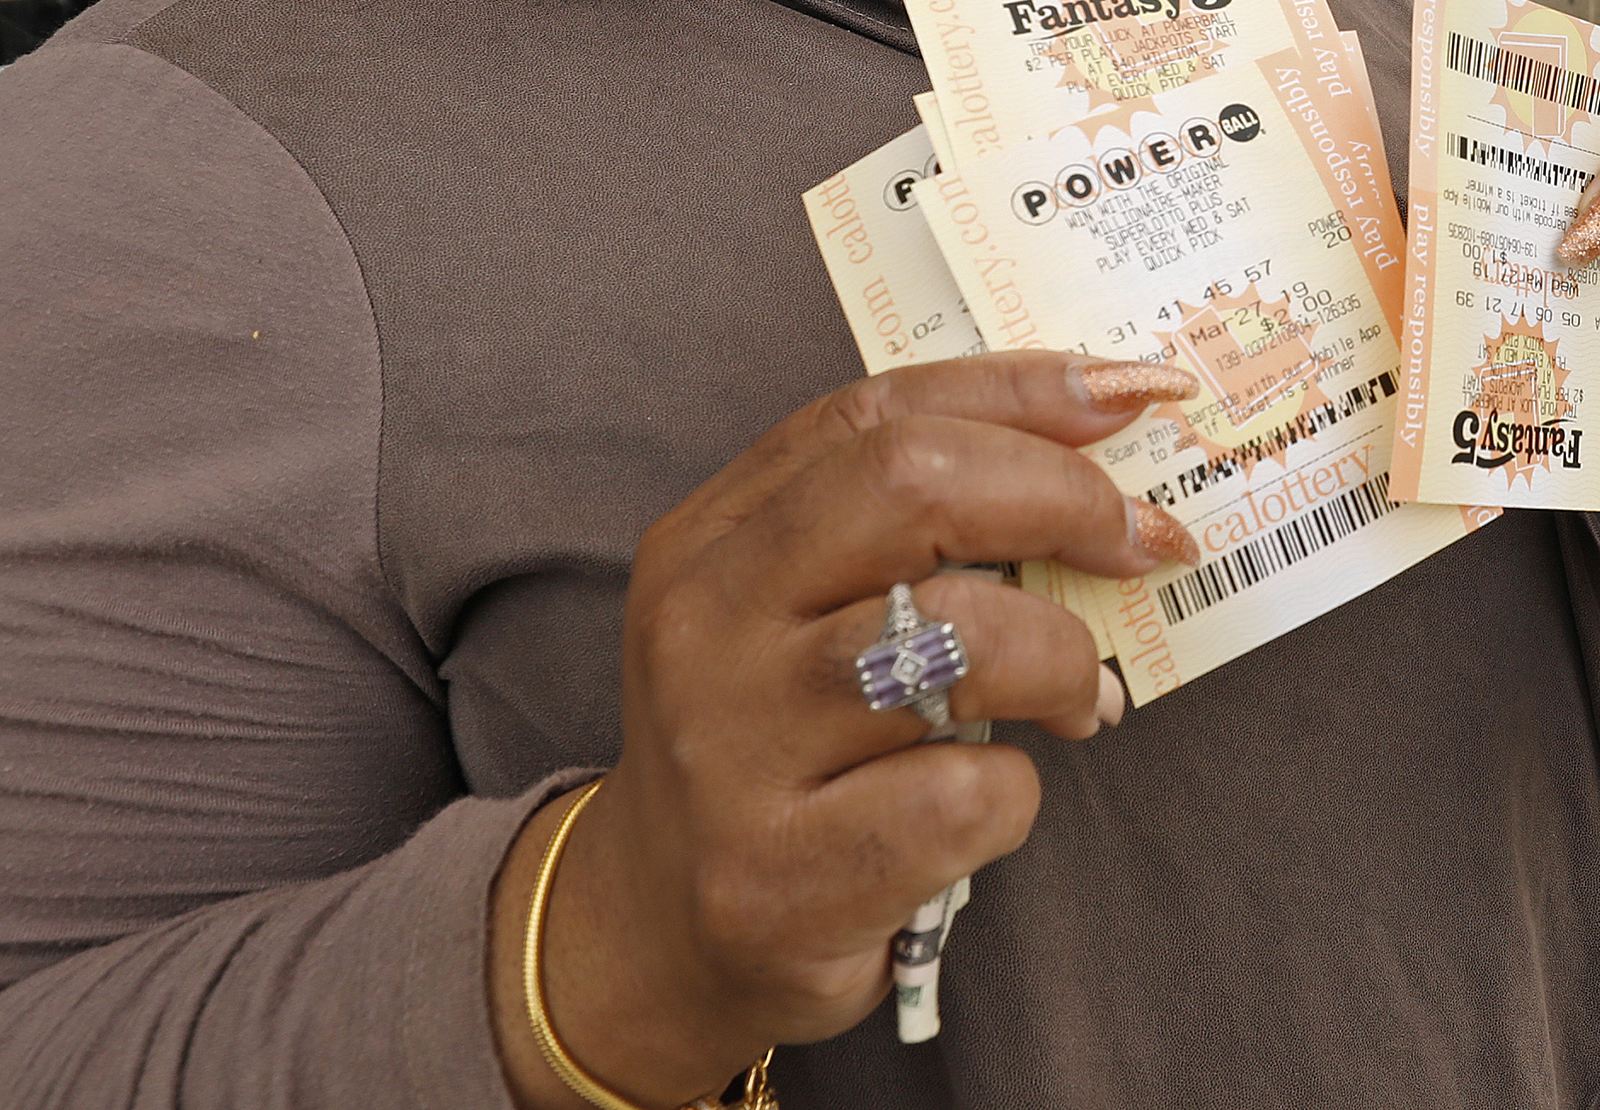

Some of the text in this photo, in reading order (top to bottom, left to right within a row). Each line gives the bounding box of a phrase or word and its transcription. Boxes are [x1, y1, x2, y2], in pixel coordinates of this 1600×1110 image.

[1062, 35, 1094, 50] YOUR
[1141, 24, 1156, 37] AT
[1164, 12, 1235, 33] POWERBALL
[1131, 32, 1195, 53] JACKPOTS
[1200, 24, 1238, 41] START
[1066, 78, 1101, 94] PLAY
[1108, 70, 1149, 88] EVERY
[1157, 63, 1182, 78] WED
[1201, 54, 1227, 69] SAT
[1111, 76, 1191, 101] QUICK PICK
[1065, 211, 1094, 230] WIN
[1136, 184, 1162, 204] THE
[1166, 156, 1230, 187] ORIGINAL
[1443, 189, 1567, 233] App Mobile our with barcode
[1465, 179, 1496, 200] winner
[1520, 196, 1547, 214] ticket
[1096, 250, 1131, 274] PLAY
[1134, 230, 1177, 257] EVERY
[1184, 214, 1209, 234] WED
[1225, 197, 1252, 219] SAT
[1105, 192, 1223, 251] SUPERLOTTO PLUS
[1308, 210, 1348, 237] POWER
[1322, 225, 1352, 249] 20
[1142, 230, 1224, 271] QUICK PICK
[1473, 261, 1488, 277] 19
[1107, 259, 1273, 345] 31 41 45 57
[1280, 281, 1310, 304] 19
[1551, 277, 1580, 297] Wed
[912, 312, 946, 340] 02
[1400, 204, 1433, 449] play responsibly
[1455, 290, 1600, 330] A 05 06 17 21 39
[1477, 343, 1492, 360] SAT
[1103, 439, 1142, 467] Scan
[1147, 421, 1181, 446] this
[1184, 392, 1242, 427] barcode
[1244, 373, 1278, 400] with
[1310, 336, 1355, 364] Mobile
[1358, 322, 1383, 345] App
[1150, 449, 1168, 465] to
[1225, 396, 1275, 428] ticket
[1313, 352, 1358, 383] winner
[1573, 388, 1584, 403] $2
[1203, 445, 1373, 554] calottery
